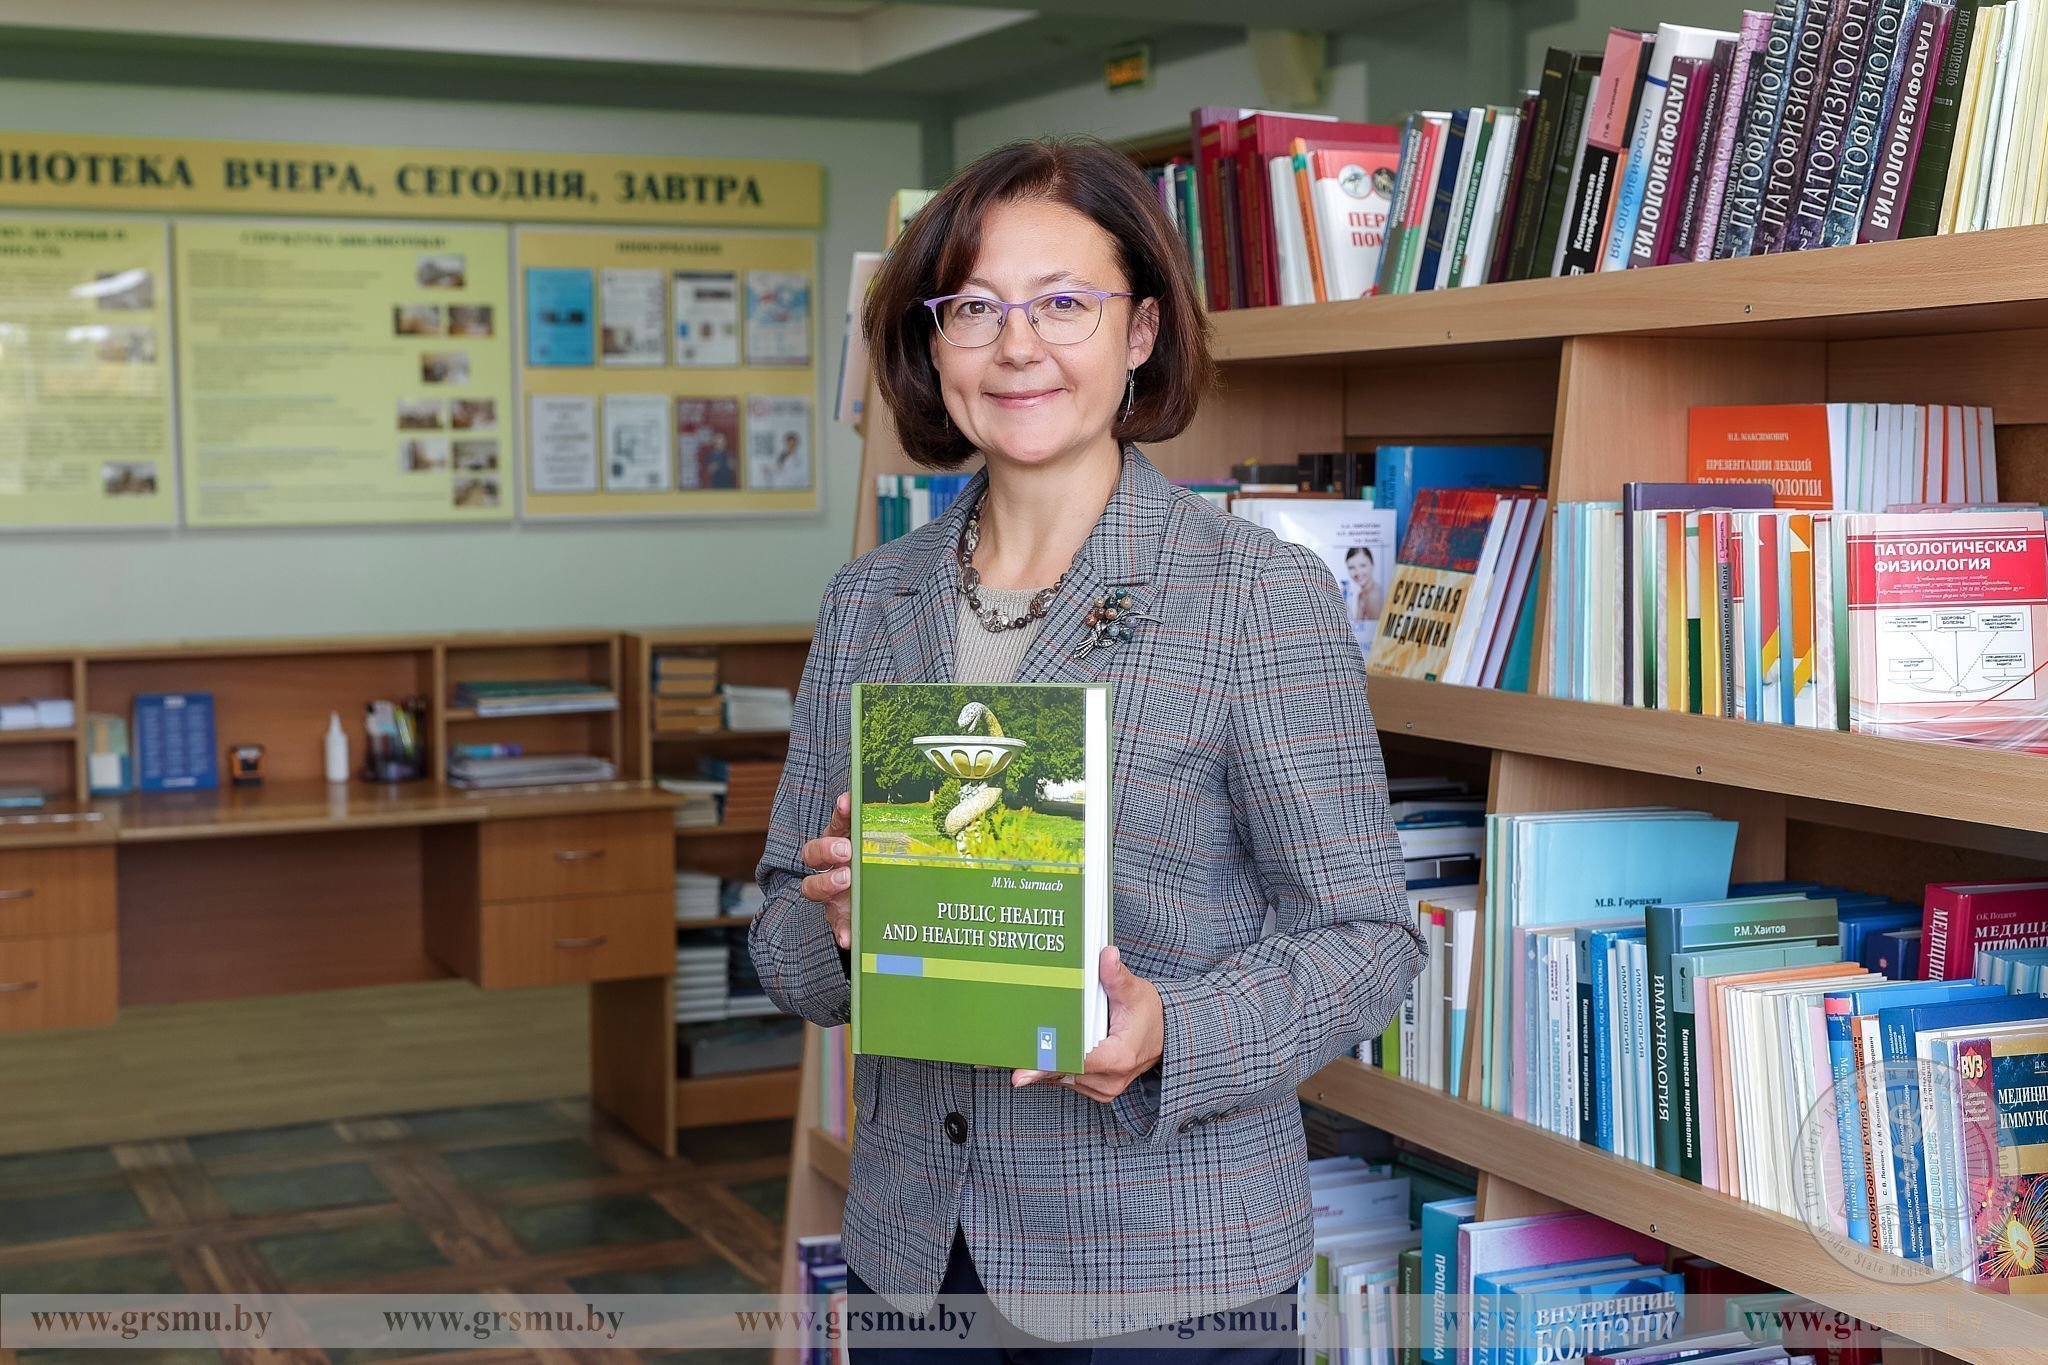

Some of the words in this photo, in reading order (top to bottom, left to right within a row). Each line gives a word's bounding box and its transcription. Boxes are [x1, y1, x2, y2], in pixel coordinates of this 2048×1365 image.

[1945, 9, 1971, 87] ФИЗИОЛОГИЯ
[1694, 72, 1720, 171] ПАТОЛОГИЧЕСКАЯ
[1730, 0, 1797, 228] ПАТОФИЗИОЛОГИ
[1871, 20, 1935, 229] ПАТОФИЗИОЛОГИЯ
[223, 157, 377, 197] ВЧЕРА,
[397, 163, 597, 203] СЕГОДНЯ,
[615, 170, 762, 206] ЗАВТРА
[1611, 108, 1653, 259] ПАТОФИЗИОЛОГИЯ
[1633, 73, 1688, 259] ПАТОФИЗИОЛОГИЯ
[1733, 142, 1745, 178] ОБЩАЯ
[1573, 173, 1597, 250] Клиническая
[1583, 156, 1610, 252] патофизиология
[1679, 174, 1700, 248] ФИЗИОЛОГИЯ
[1799, 226, 1814, 239] Том
[1833, 222, 1846, 235] Том
[1706, 459, 1772, 472] ПРЕЗЕНТАЦИИ
[1774, 457, 1812, 472] ЛЕКЦИЙ
[1874, 540, 2028, 557] ПАТОЛОГИЧЕСКАЯ
[1874, 557, 1991, 573] ФИЗИОЛОГИЯ
[1393, 579, 1463, 614] СУДЕБНАЯ
[1721, 565, 1729, 590] Атлас
[1382, 612, 1452, 648] МЕДИЦИНА
[991, 876, 1017, 889] M.Yu.
[1019, 877, 1064, 892] Surmach
[1595, 898, 1617, 907] М.В.
[882, 924, 919, 942] AND
[922, 926, 985, 947] HEALTH
[988, 930, 1065, 952] SERVICES
[937, 902, 996, 923] PUBLIC
[999, 906, 1065, 928] HEALTH
[1733, 926, 1753, 937] Р.М.
[1754, 924, 1787, 936] Хаитов
[1621, 965, 1630, 1054] ИММУНОЛОГИЯ
[1635, 968, 1645, 1058] ИММУНОЛОГИЯ
[1654, 974, 1670, 1122] ИММУНОЛОГИЯ
[1682, 1028, 1691, 1087] Клиническая
[1961, 1054, 1985, 1080] ВУЗ
[1840, 1057, 1852, 1132] Медицинская
[1684, 1089, 1693, 1159] микробиология
[1860, 1101, 1871, 1146] ОБЩАЯ
[1907, 1198, 1912, 1208] ПО
[1433, 1253, 1446, 1360] ПРОПЕДЕВТИКА
[1536, 1291, 1676, 1326] ВНУТРЕННИЕ
[1535, 1311, 1677, 1365] БОЛЕЗНИ
